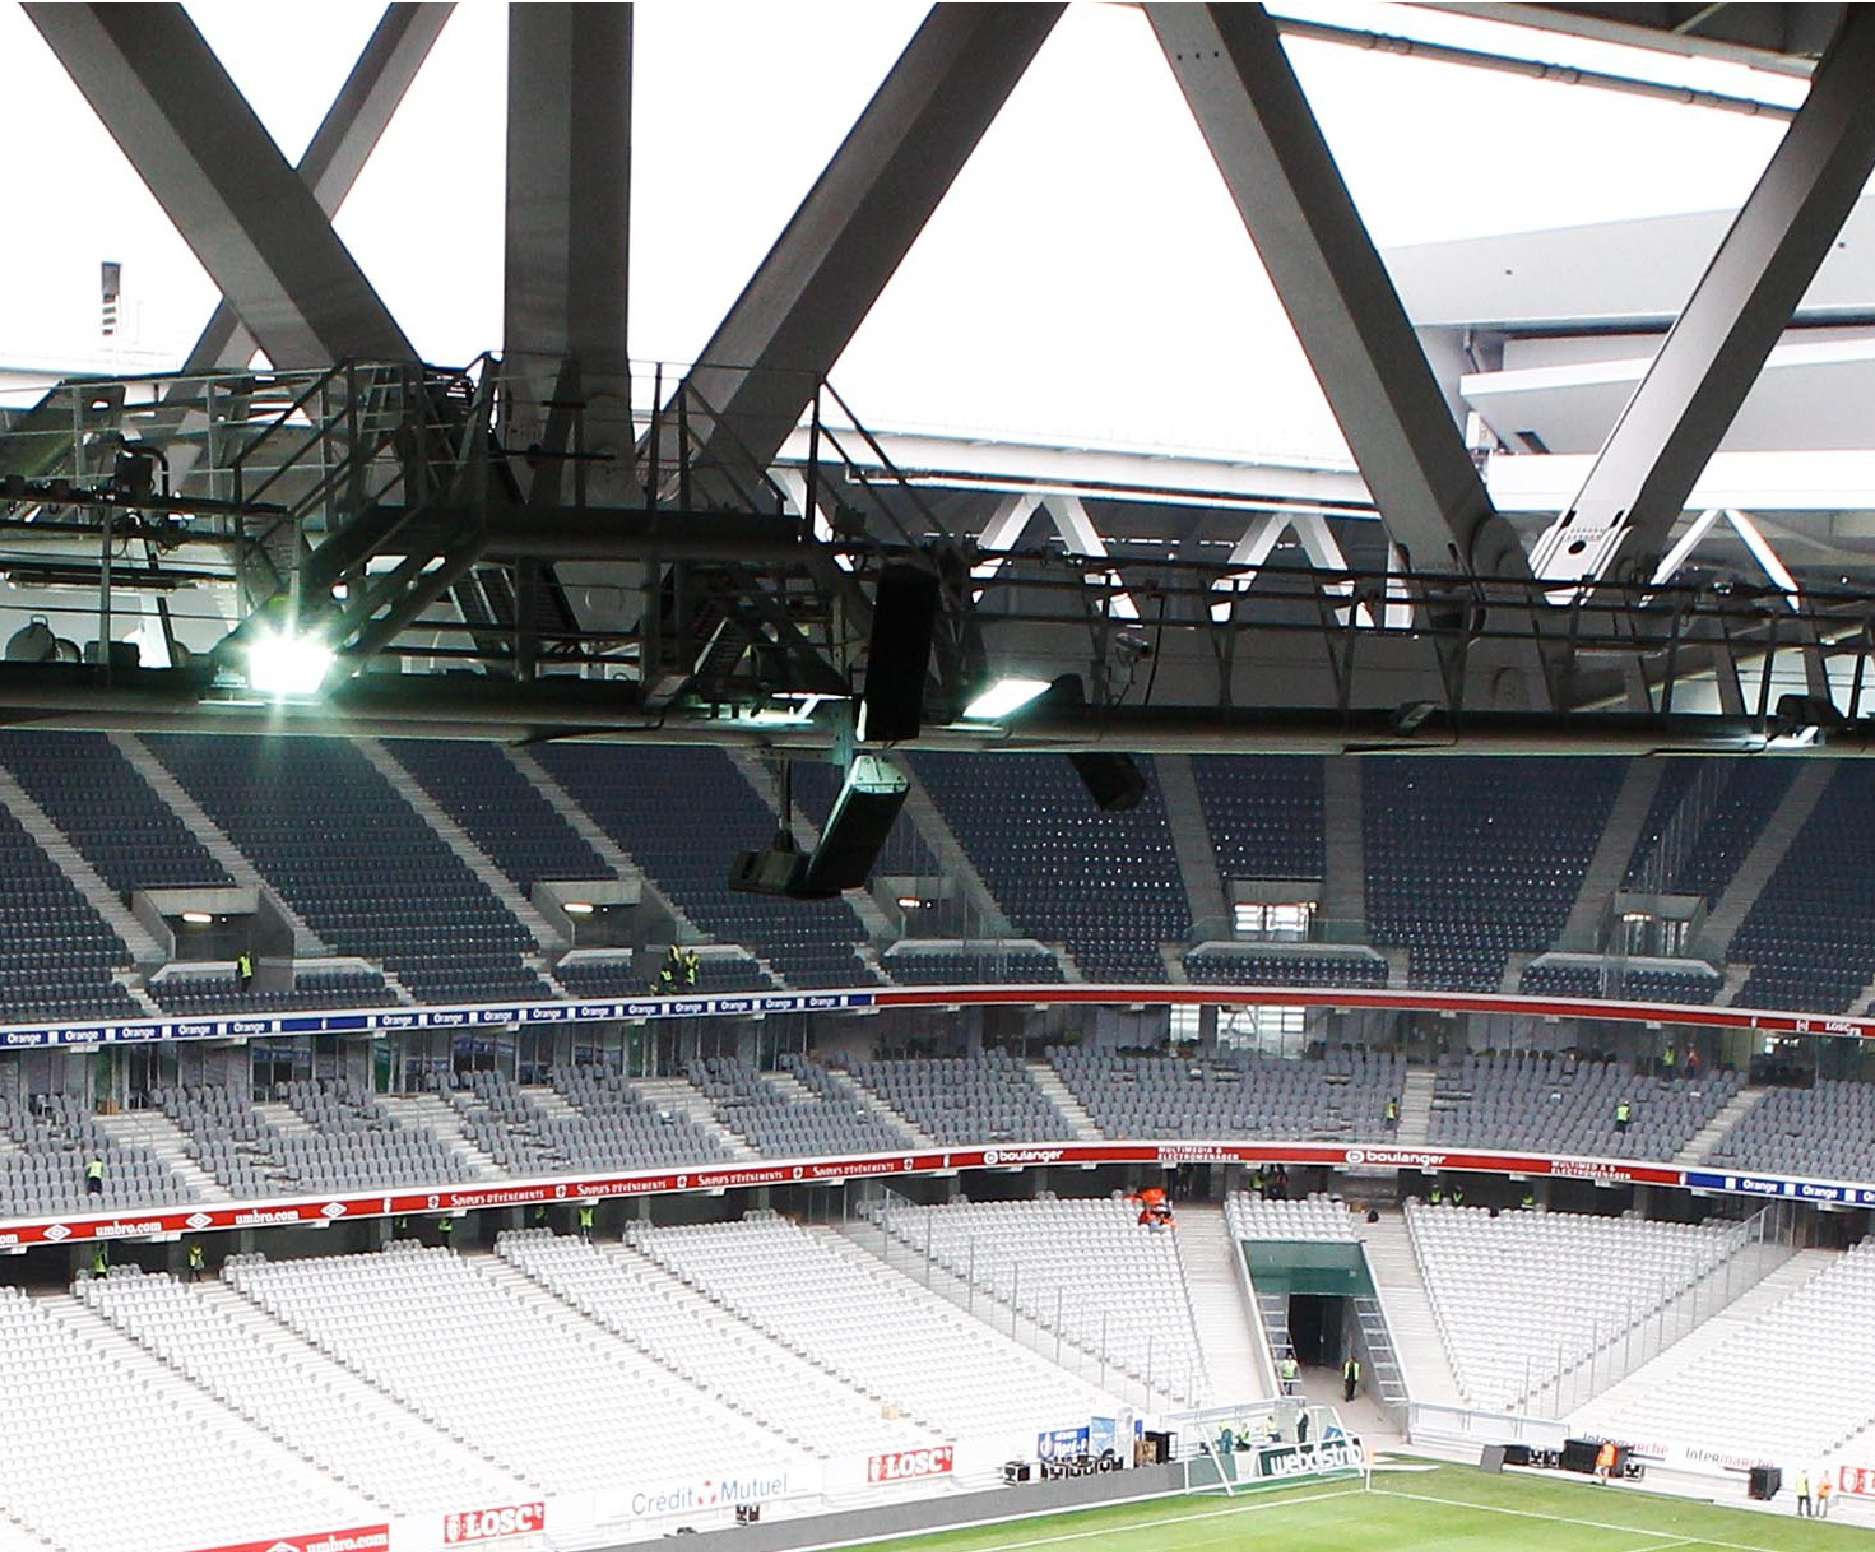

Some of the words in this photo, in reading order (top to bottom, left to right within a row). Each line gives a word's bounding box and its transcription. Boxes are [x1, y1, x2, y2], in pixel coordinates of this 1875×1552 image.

[675, 1002, 702, 1012] Orange
[721, 1000, 748, 1010] Orange
[765, 999, 792, 1009] Orange
[810, 997, 837, 1007] Orange
[532, 1009, 562, 1019] Orange
[581, 1007, 609, 1017] Orange
[629, 1005, 657, 1015] Orange
[383, 1015, 413, 1026] Orange
[434, 1014, 464, 1024] Orange
[483, 1011, 513, 1021] Orange
[178, 1024, 211, 1036] Orange
[233, 1022, 265, 1033] Orange
[8, 1033, 42, 1045] Orange
[65, 1030, 99, 1042] Orange
[122, 1028, 155, 1039] Orange
[1000, 1150, 1063, 1164] boulanger
[1367, 1151, 1445, 1167] boulanger
[1743, 1179, 1777, 1193] Orange
[1802, 1185, 1837, 1198] Orange
[235, 1210, 298, 1225] umbro.com
[95, 1220, 162, 1236] umbro.com
[885, 1447, 943, 1477] LOSC
[631, 1488, 693, 1515] Crédit
[720, 1473, 787, 1501] Mutuel
[465, 1504, 534, 1538] LOSC
